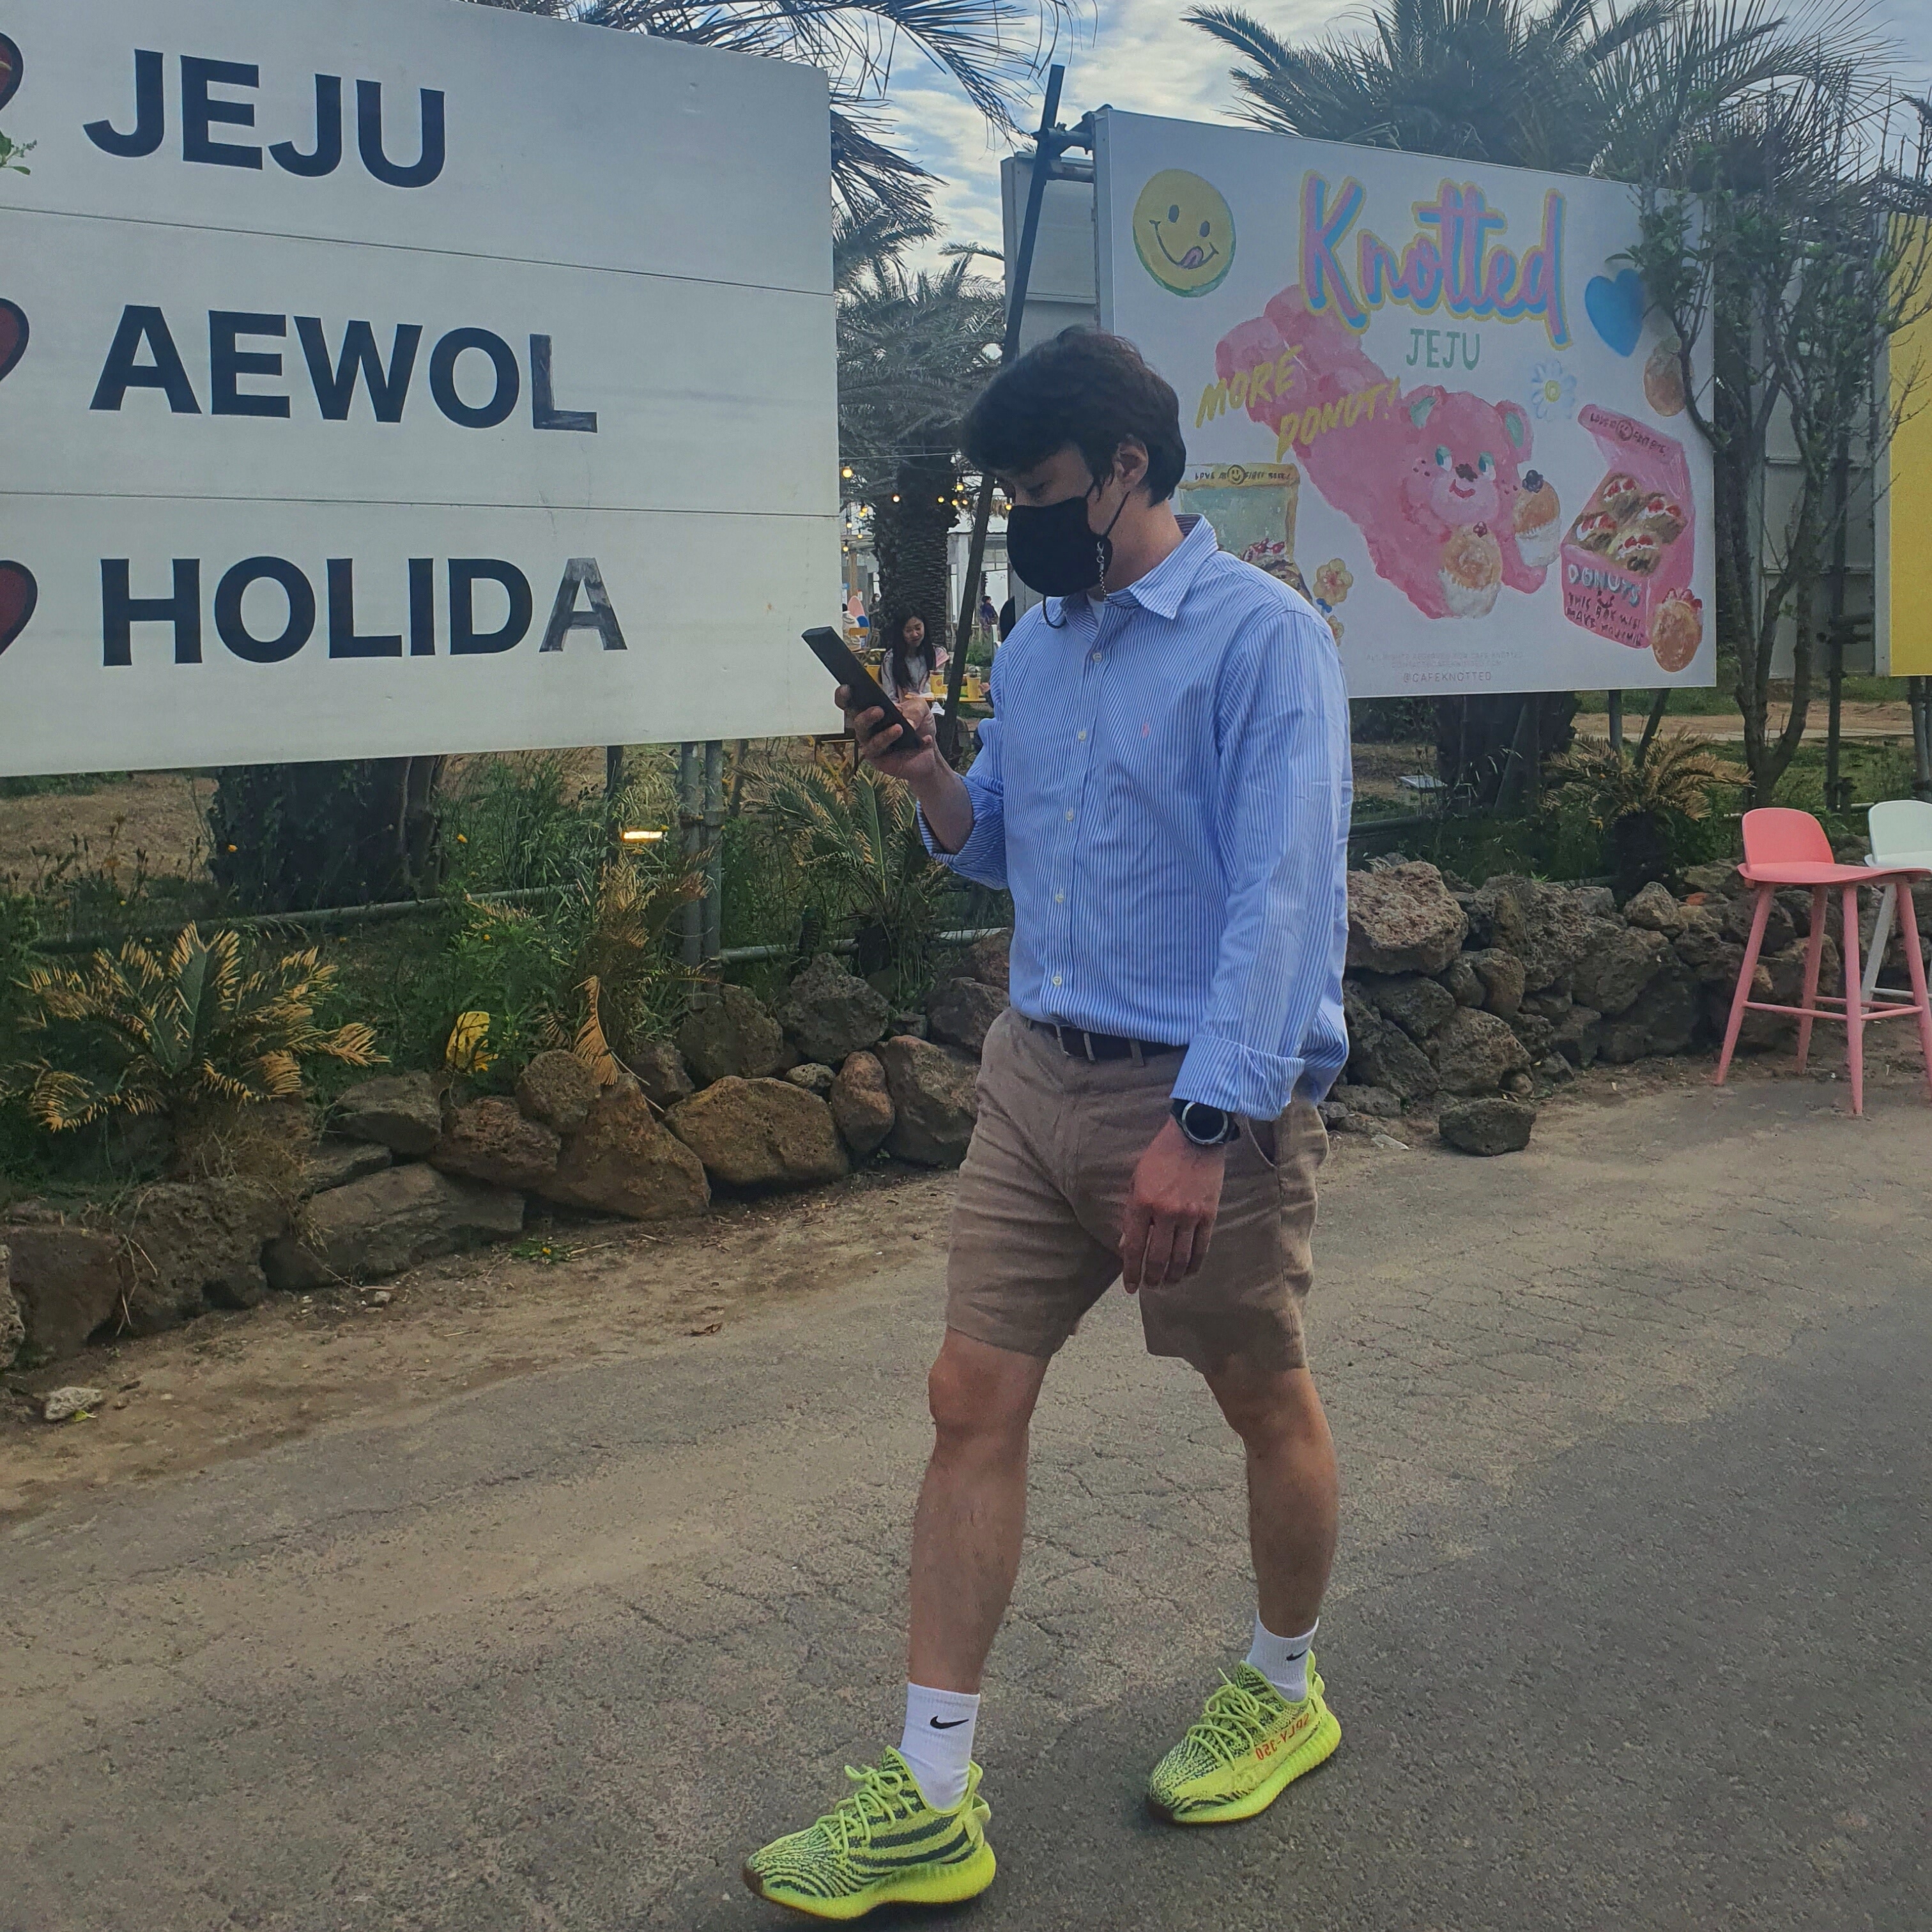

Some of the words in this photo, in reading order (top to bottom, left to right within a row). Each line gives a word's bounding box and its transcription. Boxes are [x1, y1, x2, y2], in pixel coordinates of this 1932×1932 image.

[83, 49, 446, 188] JEJU
[1299, 169, 1573, 351] Knotted
[89, 304, 598, 434] AEWOL
[1195, 344, 1303, 429] MORE
[1406, 328, 1480, 371] JEJU
[100, 555, 628, 667] HOLIDA
[1403, 671, 1492, 683] @CAFEKNOTTED
